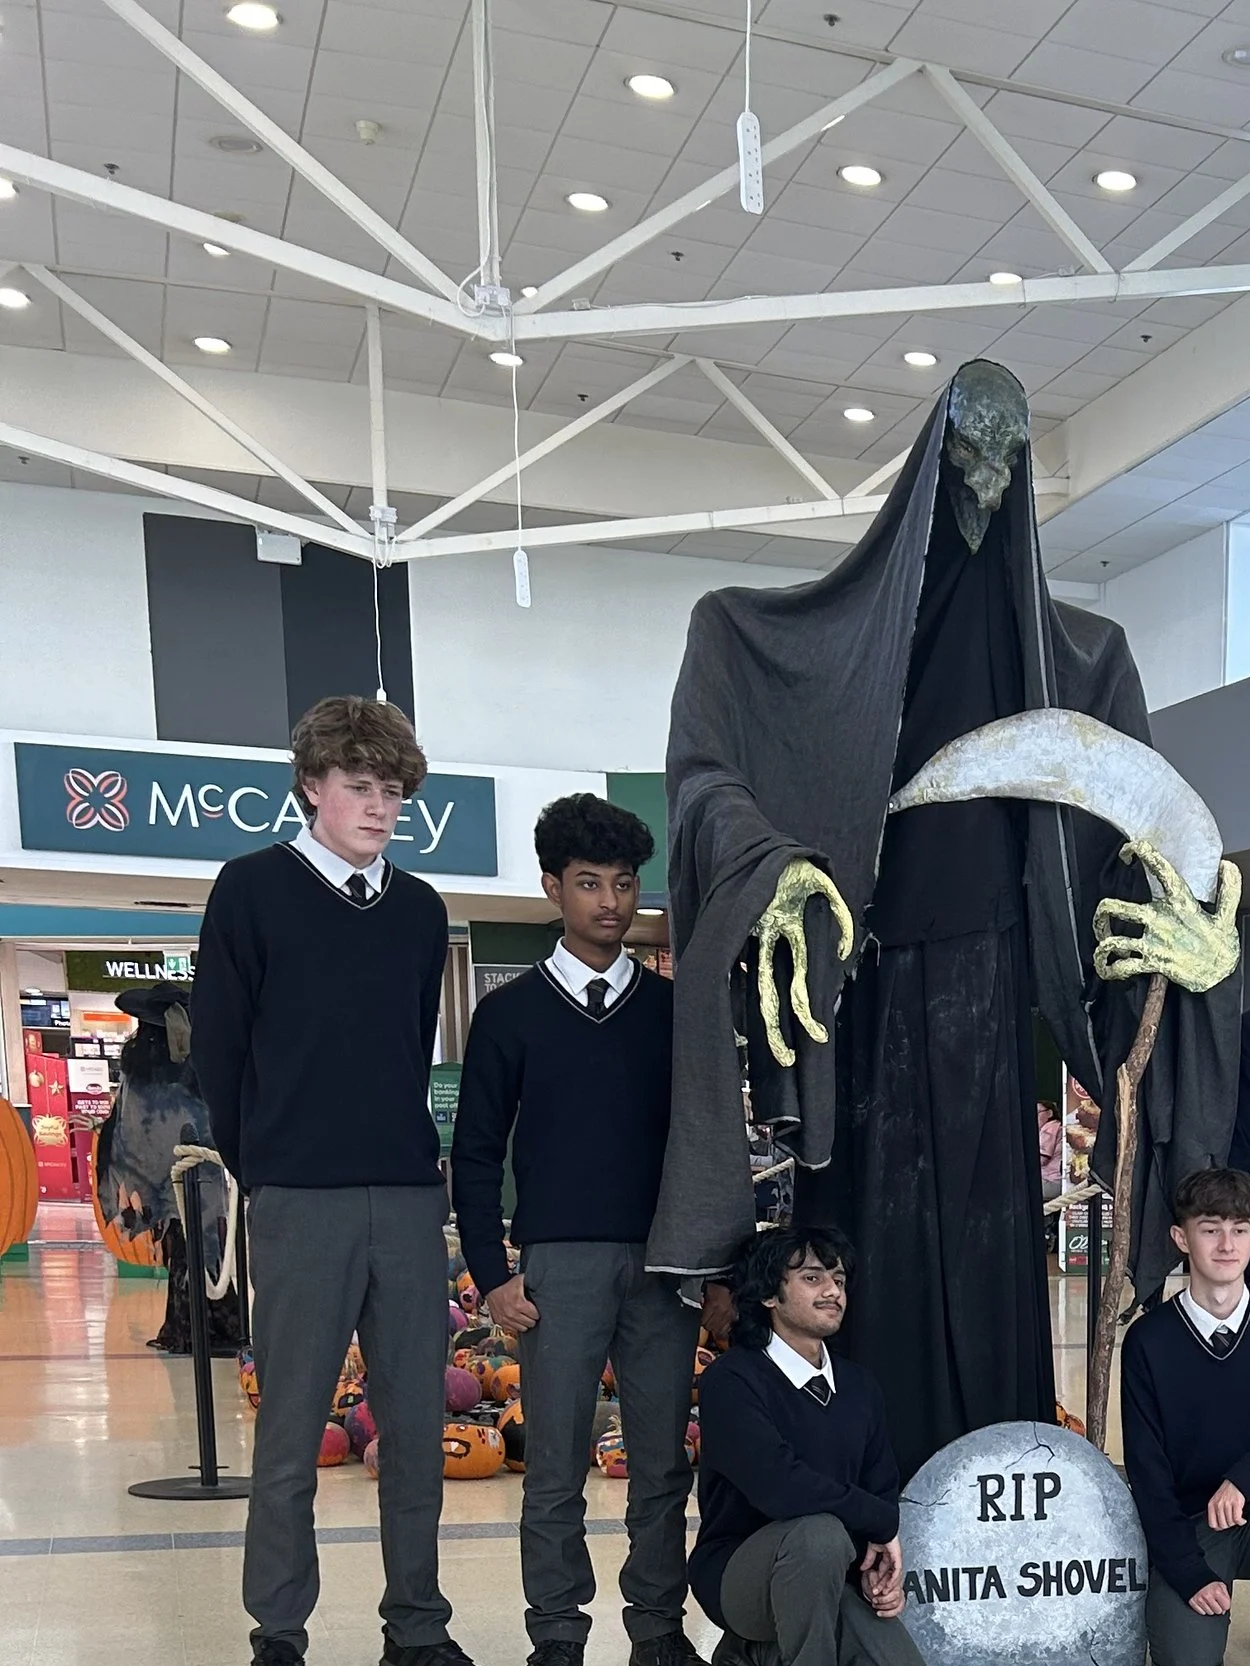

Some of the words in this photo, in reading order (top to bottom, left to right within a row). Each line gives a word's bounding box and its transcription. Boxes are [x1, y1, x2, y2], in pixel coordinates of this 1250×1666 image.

[976, 1471, 1062, 1522] RIP
[902, 1565, 1007, 1605] ANITA
[1016, 1557, 1147, 1598] SHOVEL
